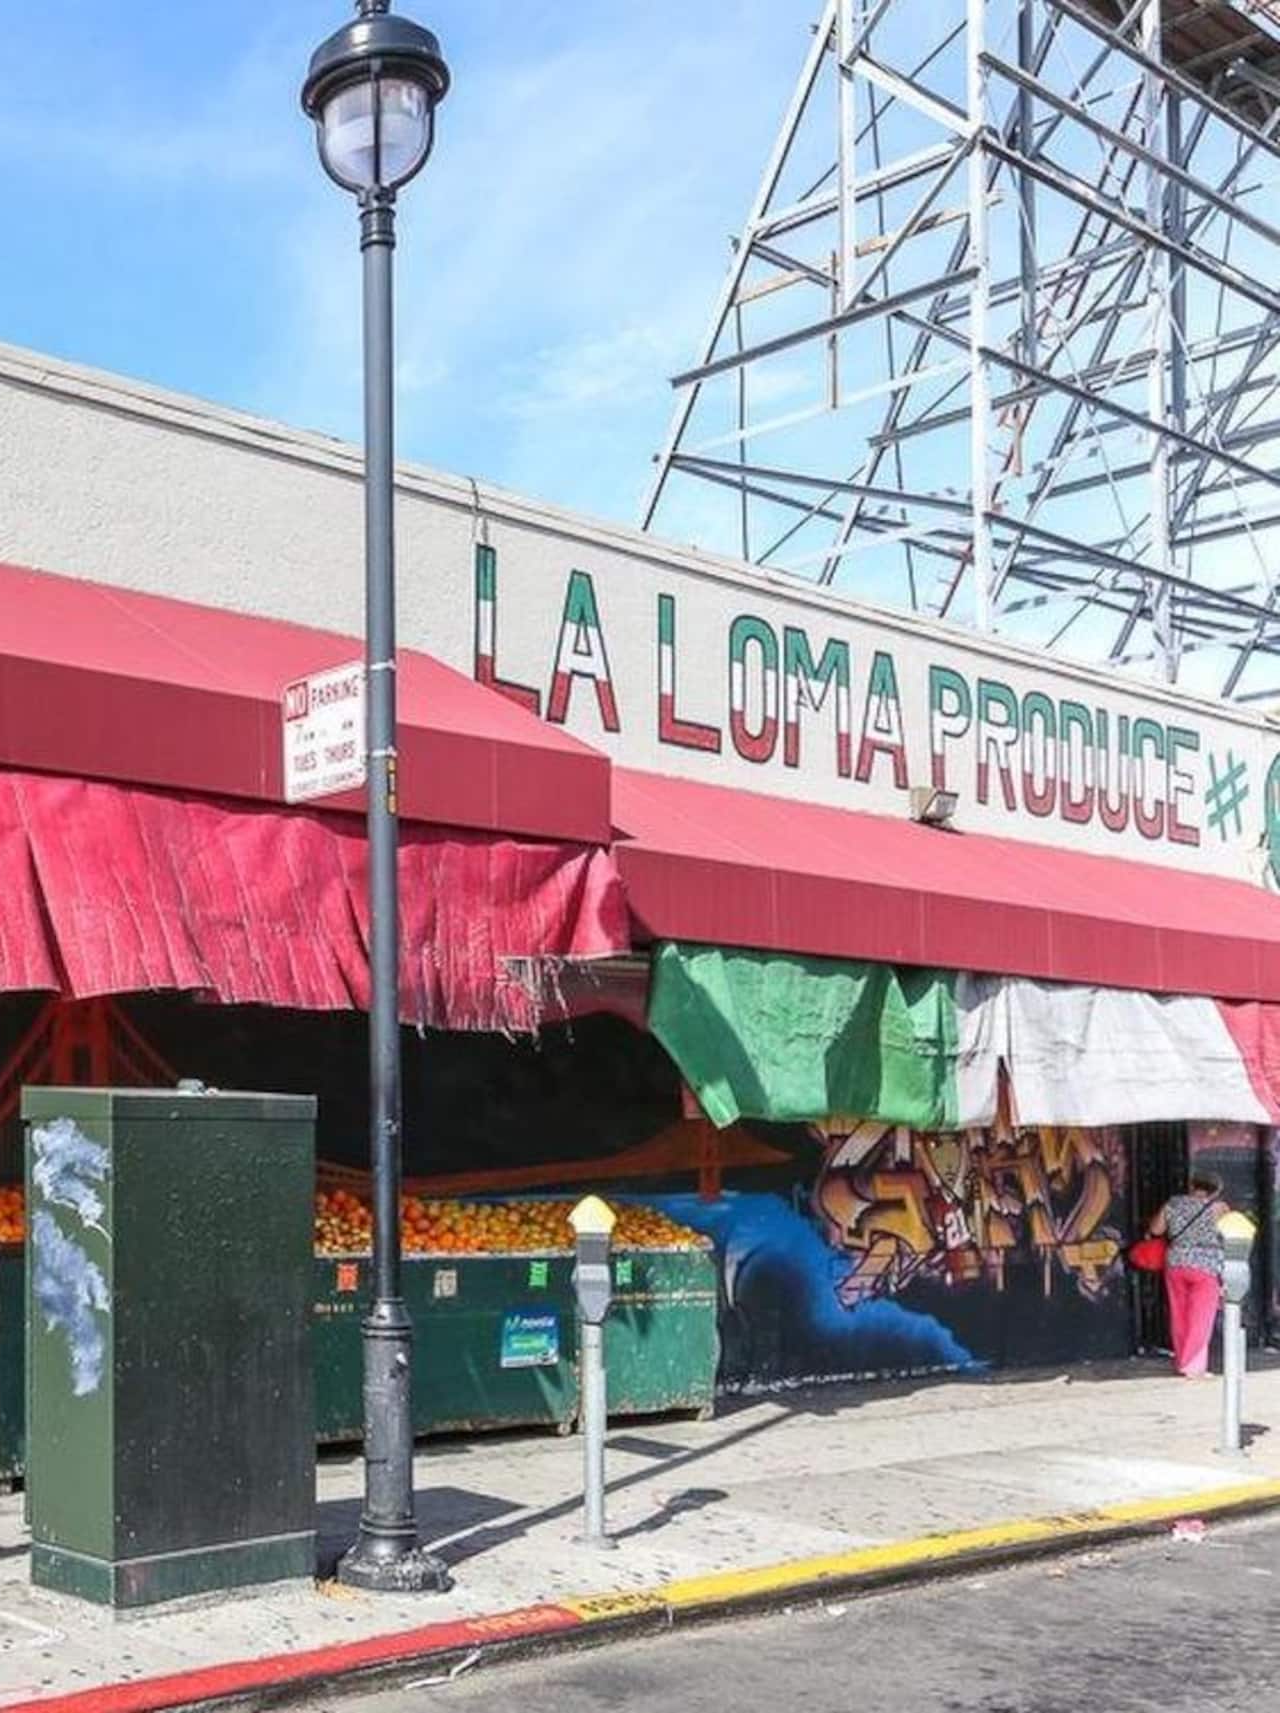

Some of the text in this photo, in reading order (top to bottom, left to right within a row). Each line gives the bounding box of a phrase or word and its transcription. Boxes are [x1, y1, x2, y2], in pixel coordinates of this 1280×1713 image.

[475, 543, 620, 733] LA
[658, 592, 909, 790] LOMA
[929, 664, 1200, 847] PRODUCE
